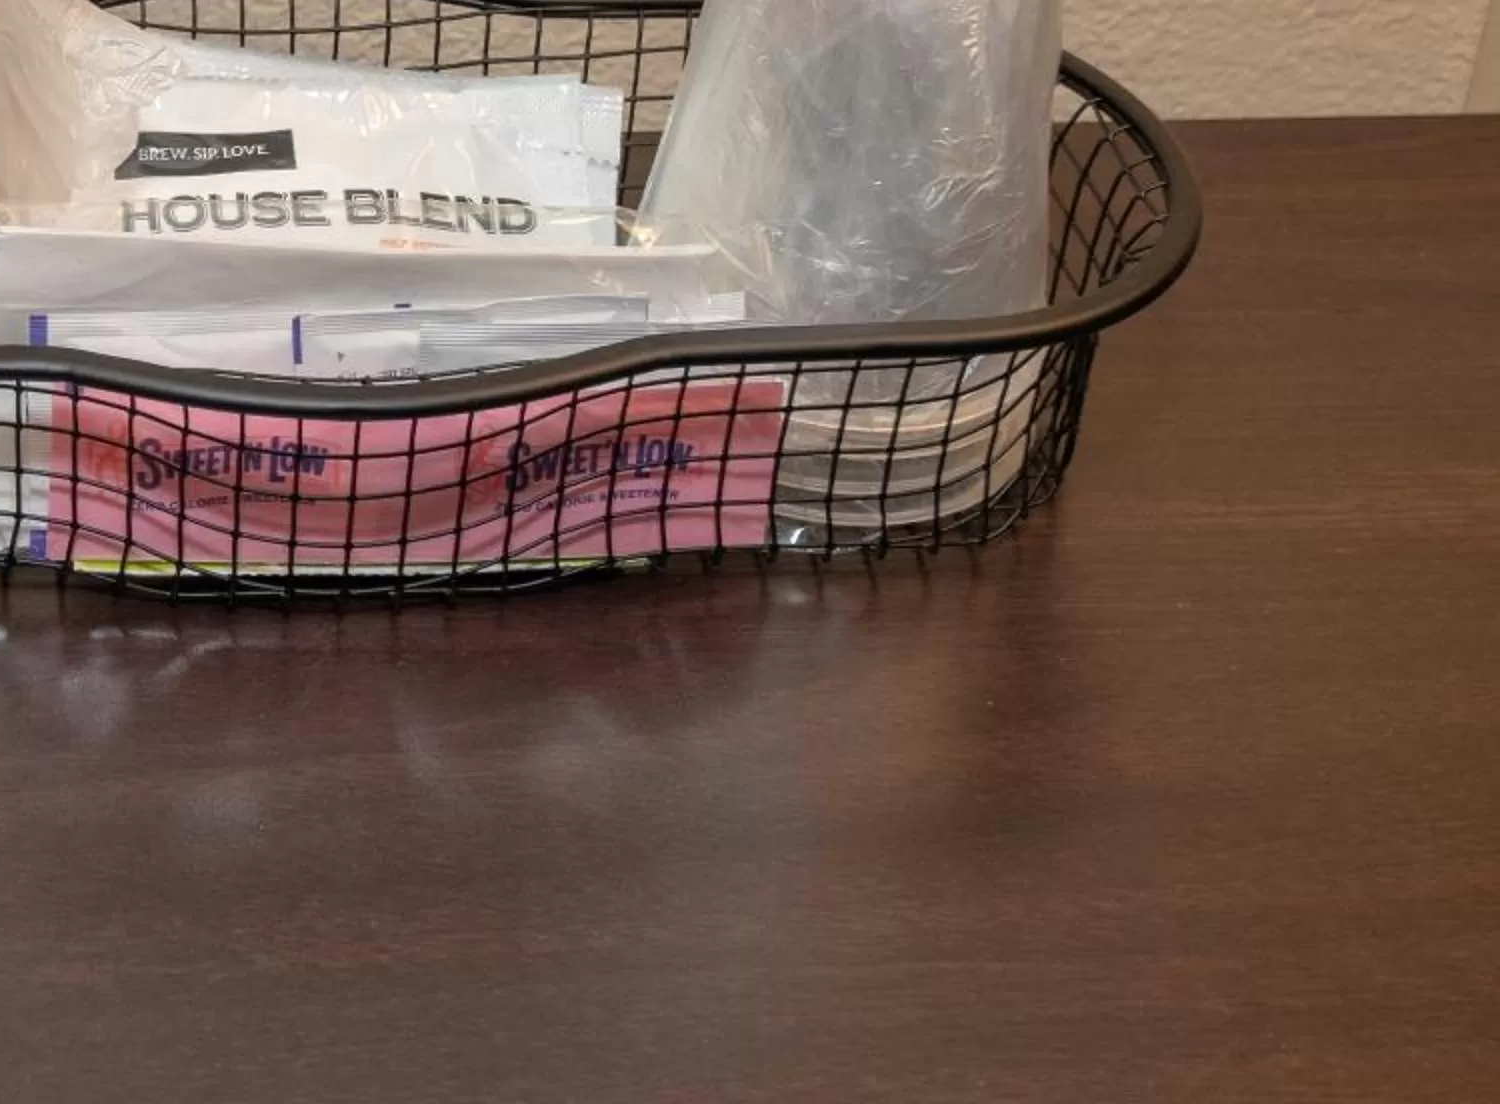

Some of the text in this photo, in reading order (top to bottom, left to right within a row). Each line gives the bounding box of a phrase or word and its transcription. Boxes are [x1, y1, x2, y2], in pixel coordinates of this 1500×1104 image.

[138, 146, 190, 162] BREW.
[121, 188, 539, 235] HOUSE BLEND
